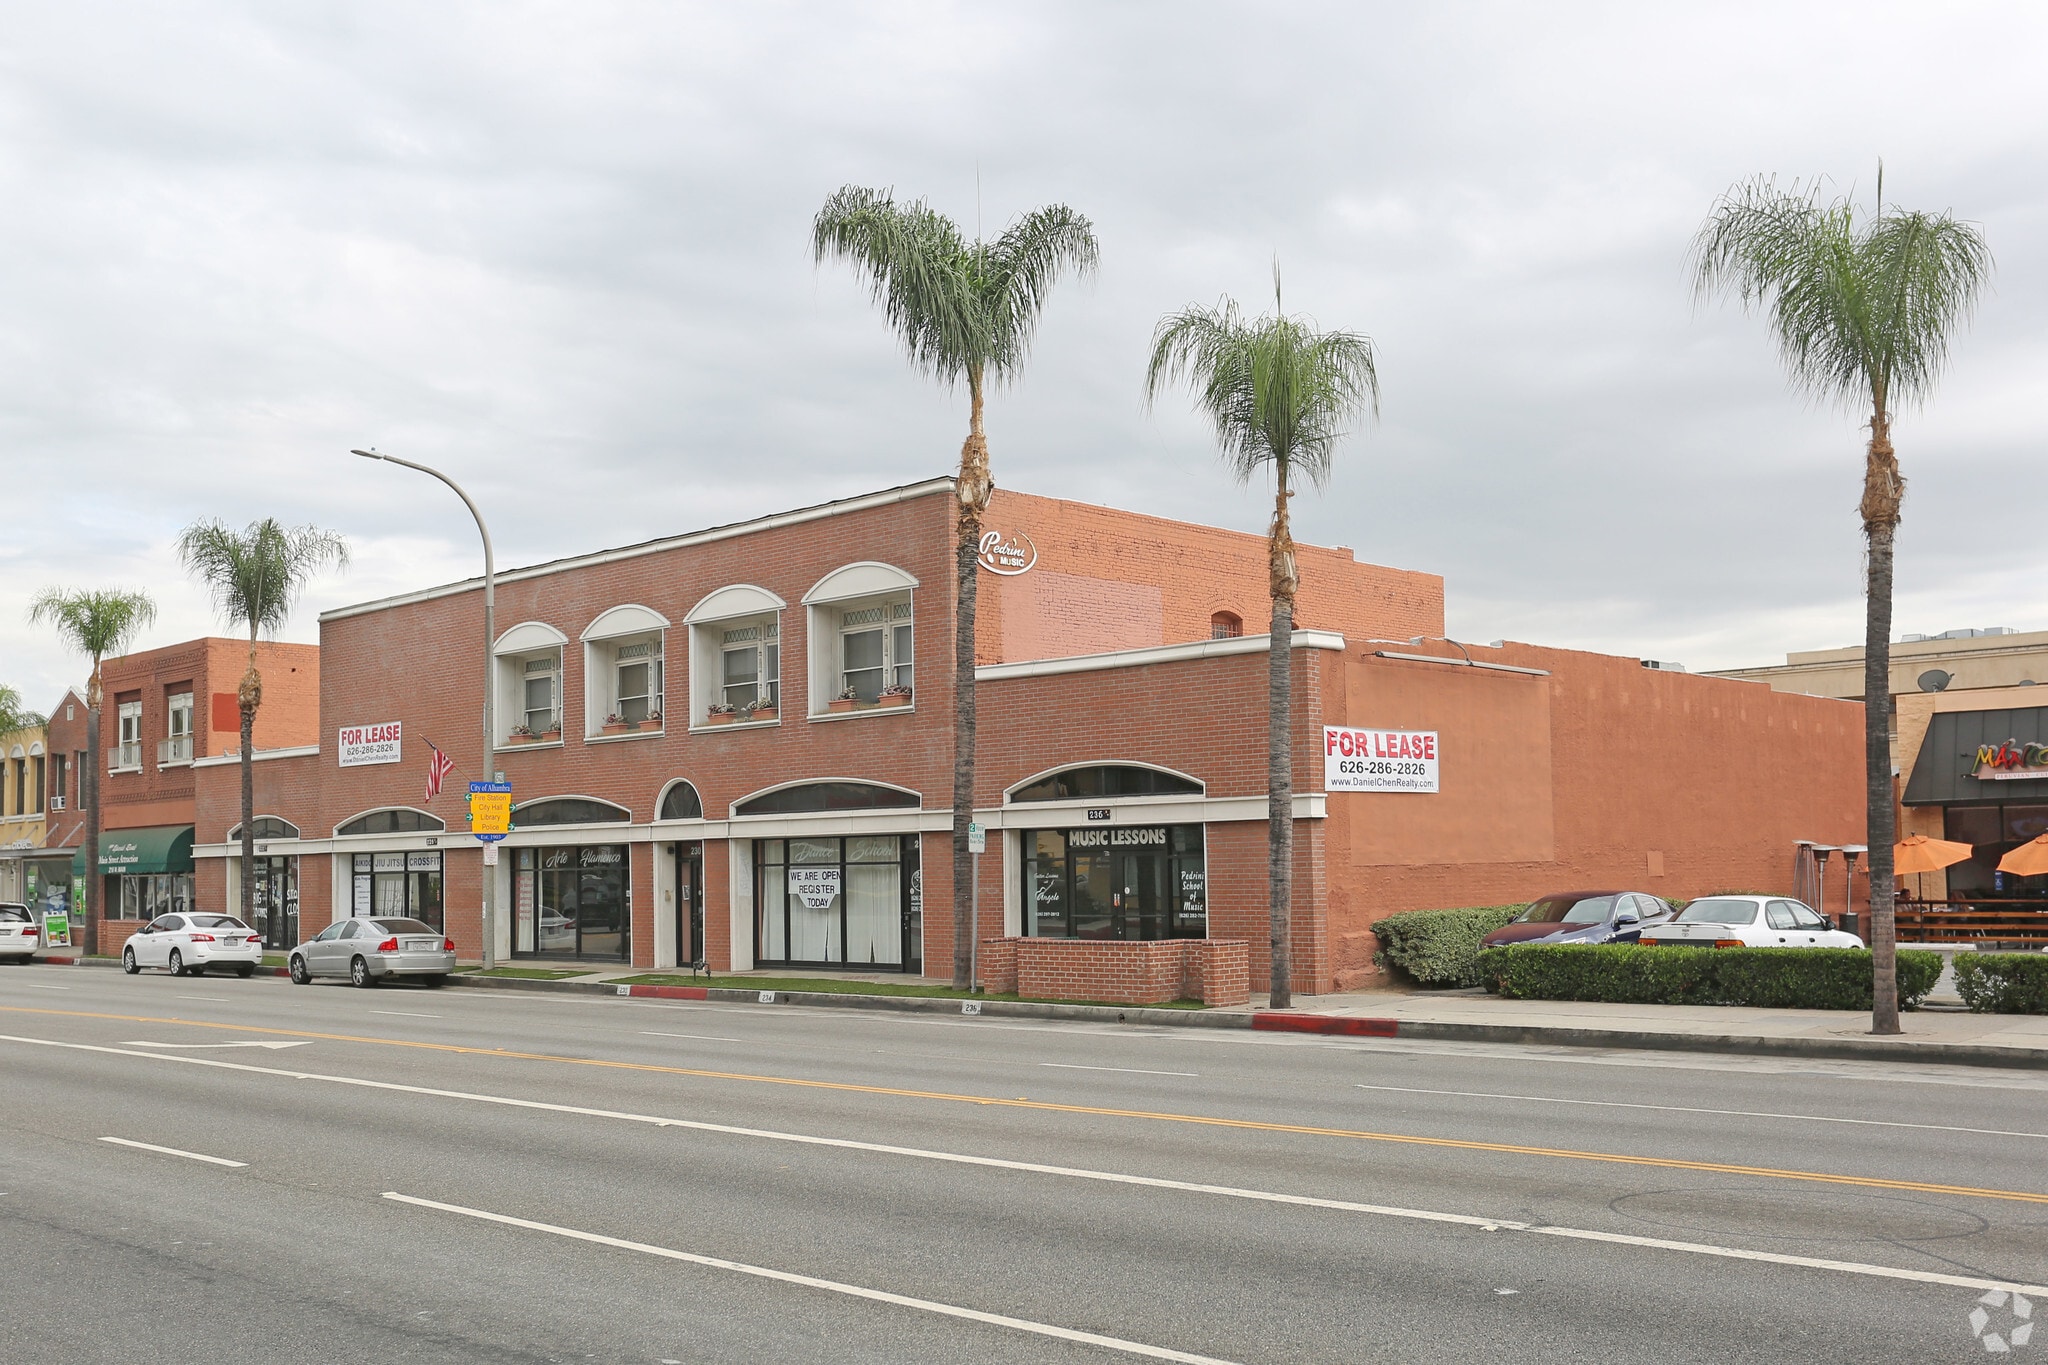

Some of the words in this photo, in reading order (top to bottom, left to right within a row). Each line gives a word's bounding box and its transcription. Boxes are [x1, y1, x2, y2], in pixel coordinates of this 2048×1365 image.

[980, 531, 1025, 557] Pedrini
[1000, 556, 1025, 567] MUSIC
[341, 729, 362, 746] FOR
[366, 725, 400, 744] LEASE
[347, 744, 394, 756] 626-286-2826
[1327, 731, 1369, 757] FOR
[1374, 733, 1435, 760] LEASE
[1340, 760, 1426, 775] 626-286-2826
[470, 784, 480, 793] City
[481, 784, 486, 792] of
[487, 784, 511, 792] Alhambra
[1331, 777, 1434, 789] www.DanielChenRealty.com
[487, 794, 507, 802] Station
[478, 803, 490, 811] City
[491, 803, 503, 811] Hall
[480, 813, 501, 822] Library
[1069, 830, 1109, 847] MUSIC
[1111, 828, 1167, 845] LESSONS
[690, 846, 702, 855] 230
[791, 842, 835, 862] Dance
[851, 842, 896, 861] School
[375, 859, 386, 868] JIU
[409, 857, 441, 867] CROSSFIT
[546, 850, 568, 868] Arte
[580, 848, 621, 867] Flamenco
[791, 871, 802, 881] WE
[804, 871, 818, 881] ARE
[821, 870, 841, 881] OPEN
[1181, 871, 1205, 880] Pedrini
[798, 885, 835, 895] REGISTER
[1182, 881, 1204, 890] School
[807, 897, 829, 907] TODAY
[1189, 891, 1197, 902] of
[1183, 901, 1204, 911] Music
